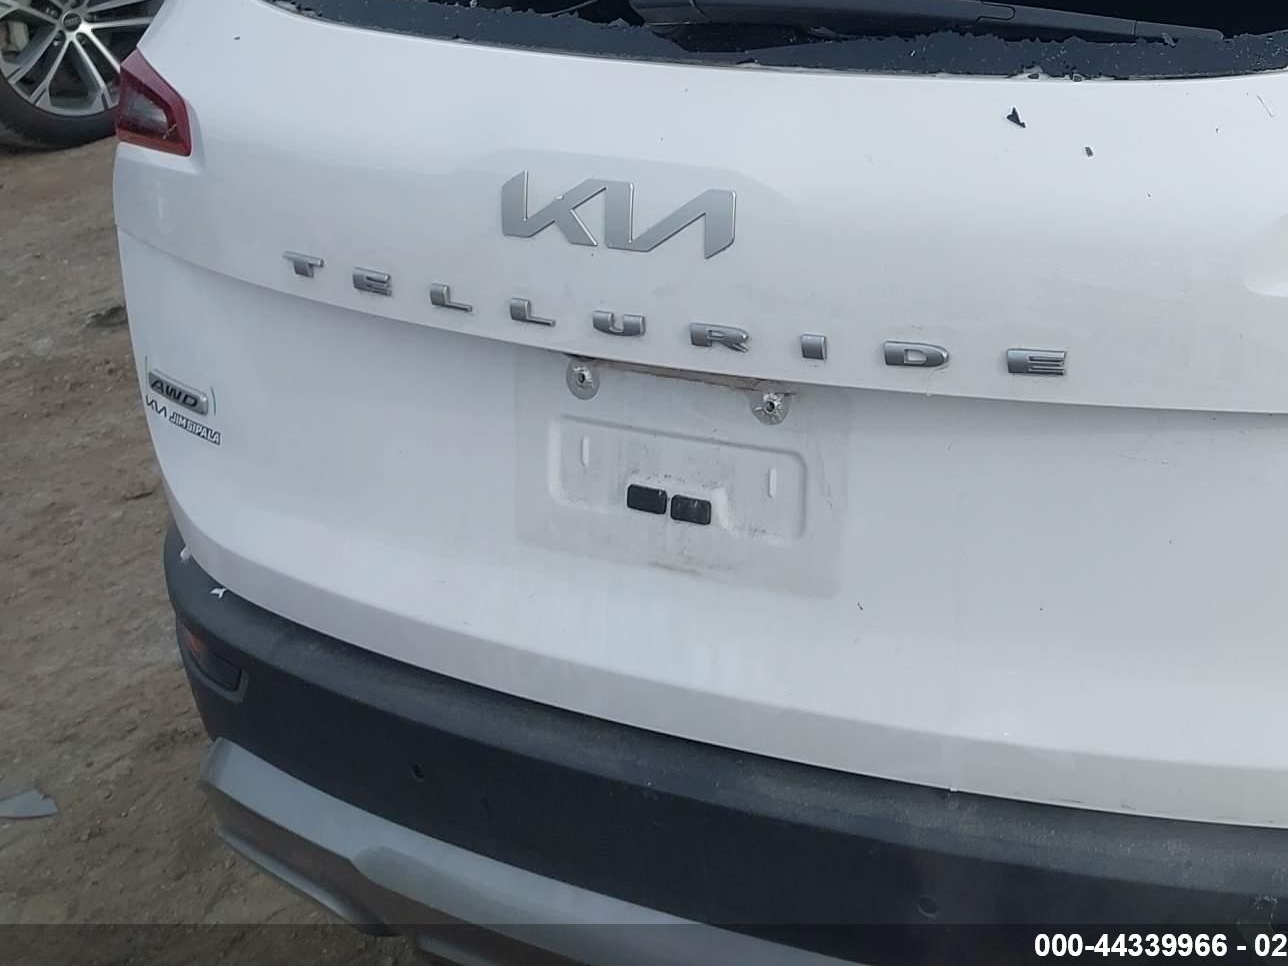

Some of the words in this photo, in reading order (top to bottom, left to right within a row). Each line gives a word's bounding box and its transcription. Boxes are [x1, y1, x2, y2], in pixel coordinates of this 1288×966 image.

[502, 169, 736, 260] KIA
[282, 250, 1067, 375] TELLURIDE
[151, 379, 198, 407] AWD
